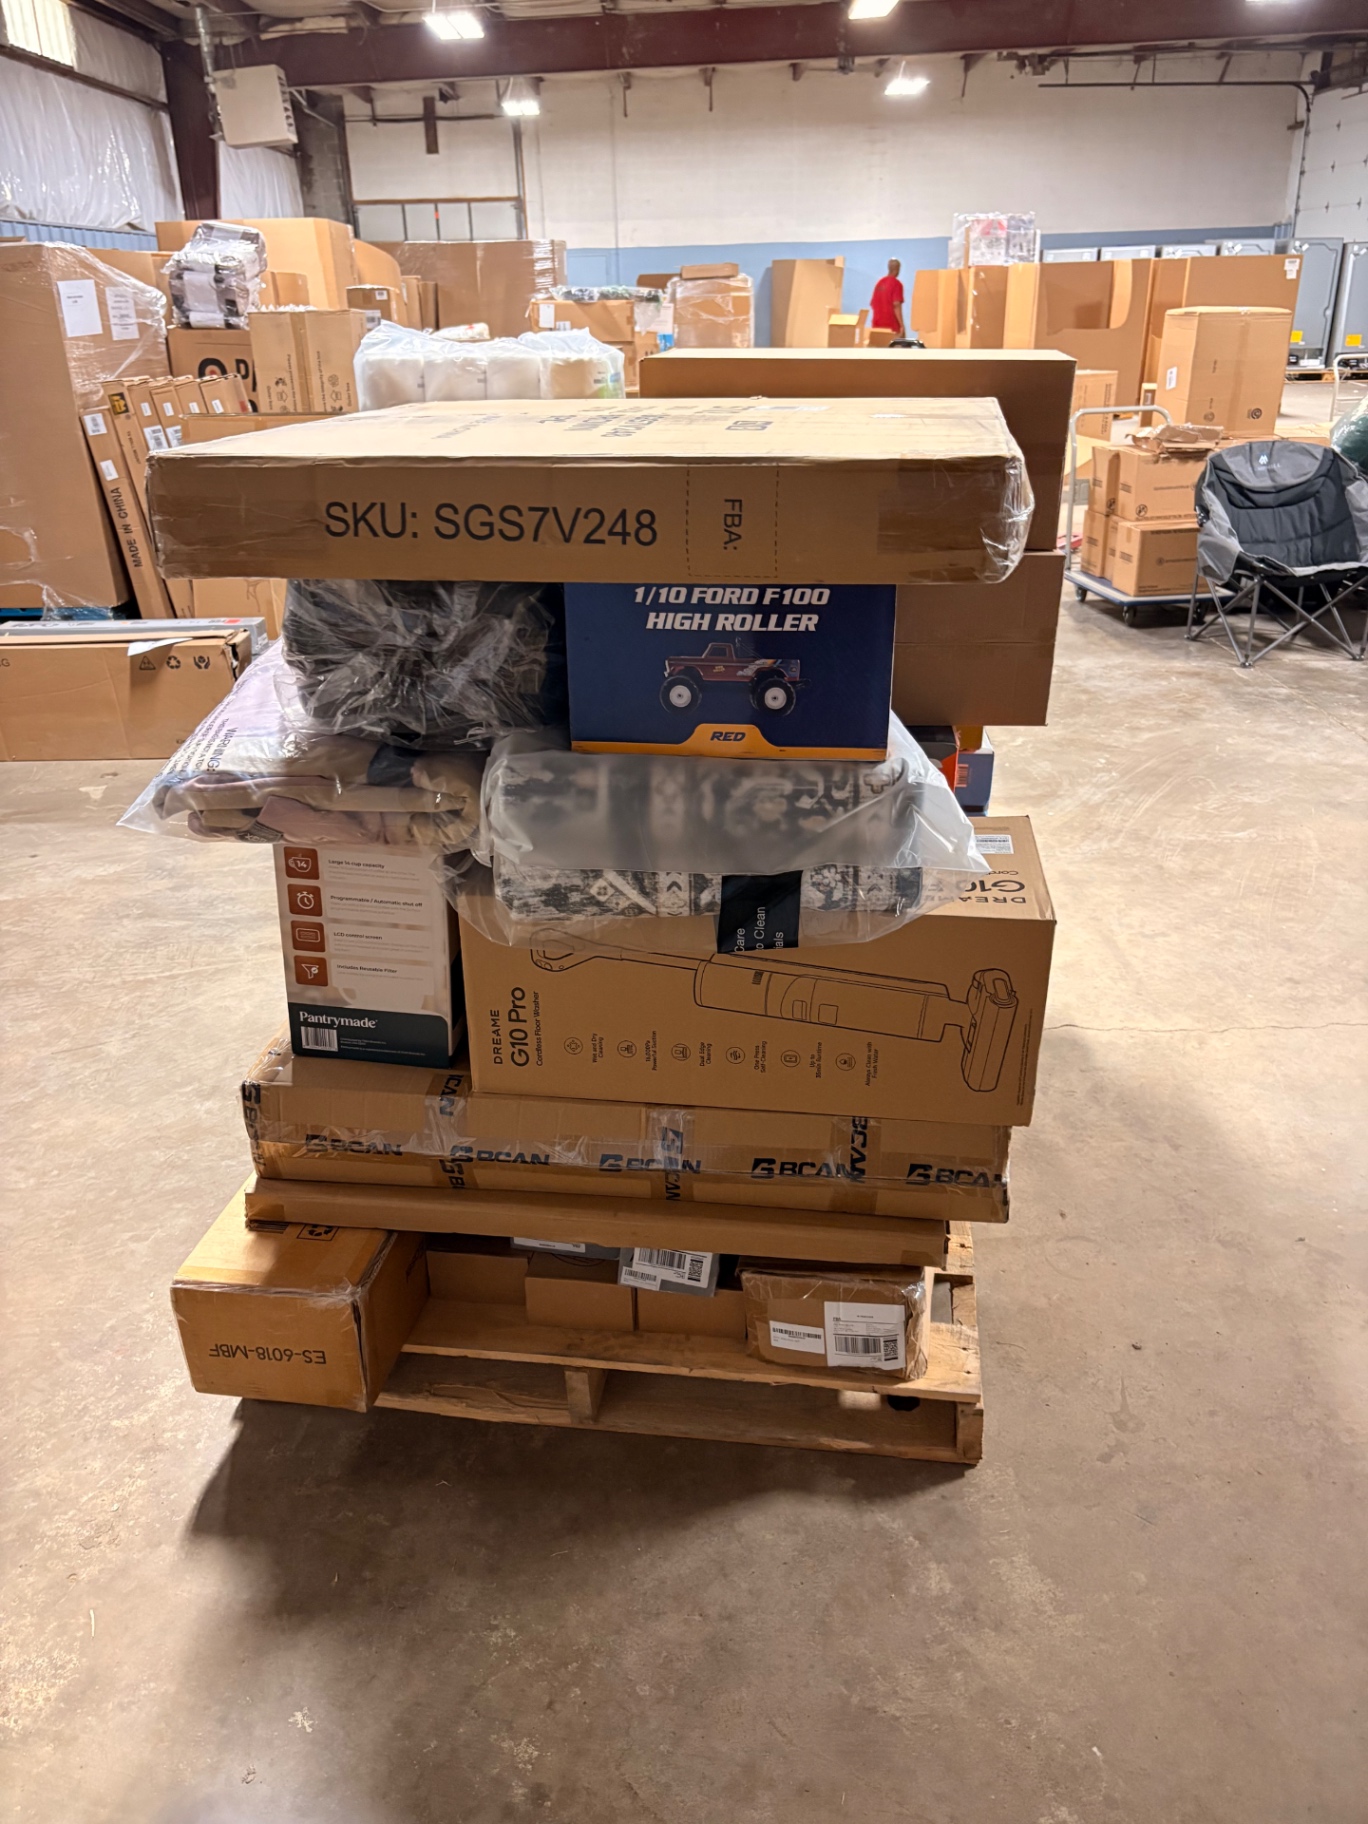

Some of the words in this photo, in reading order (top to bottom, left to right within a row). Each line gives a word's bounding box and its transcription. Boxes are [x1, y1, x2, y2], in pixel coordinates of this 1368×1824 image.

[110, 487, 128, 519] CHINA
[122, 524, 132, 534] IN
[324, 501, 419, 538] SKU:
[434, 503, 658, 547] SGS7V248
[723, 498, 743, 550] FBA:
[126, 539, 143, 567] MADE
[634, 587, 688, 605] 1/10
[690, 587, 759, 605] FORD
[762, 588, 831, 605] F100
[645, 613, 710, 631] HIGH
[714, 613, 819, 632] ROLLER
[710, 731, 746, 743] RED
[296, 860, 307, 868] 14
[330, 895, 370, 903] Programmable
[754, 906, 766, 939] Clean
[734, 928, 746, 952] Care
[773, 931, 784, 949] ials
[507, 987, 527, 1023] Pro
[532, 991, 540, 1017] Washer
[299, 1011, 376, 1029] Pantrymade
[490, 1010, 503, 1064] DREAME
[508, 1028, 529, 1067] G10
[477, 1150, 550, 1166] BCAN
[209, 1343, 326, 1365] ES-6018-MBF
